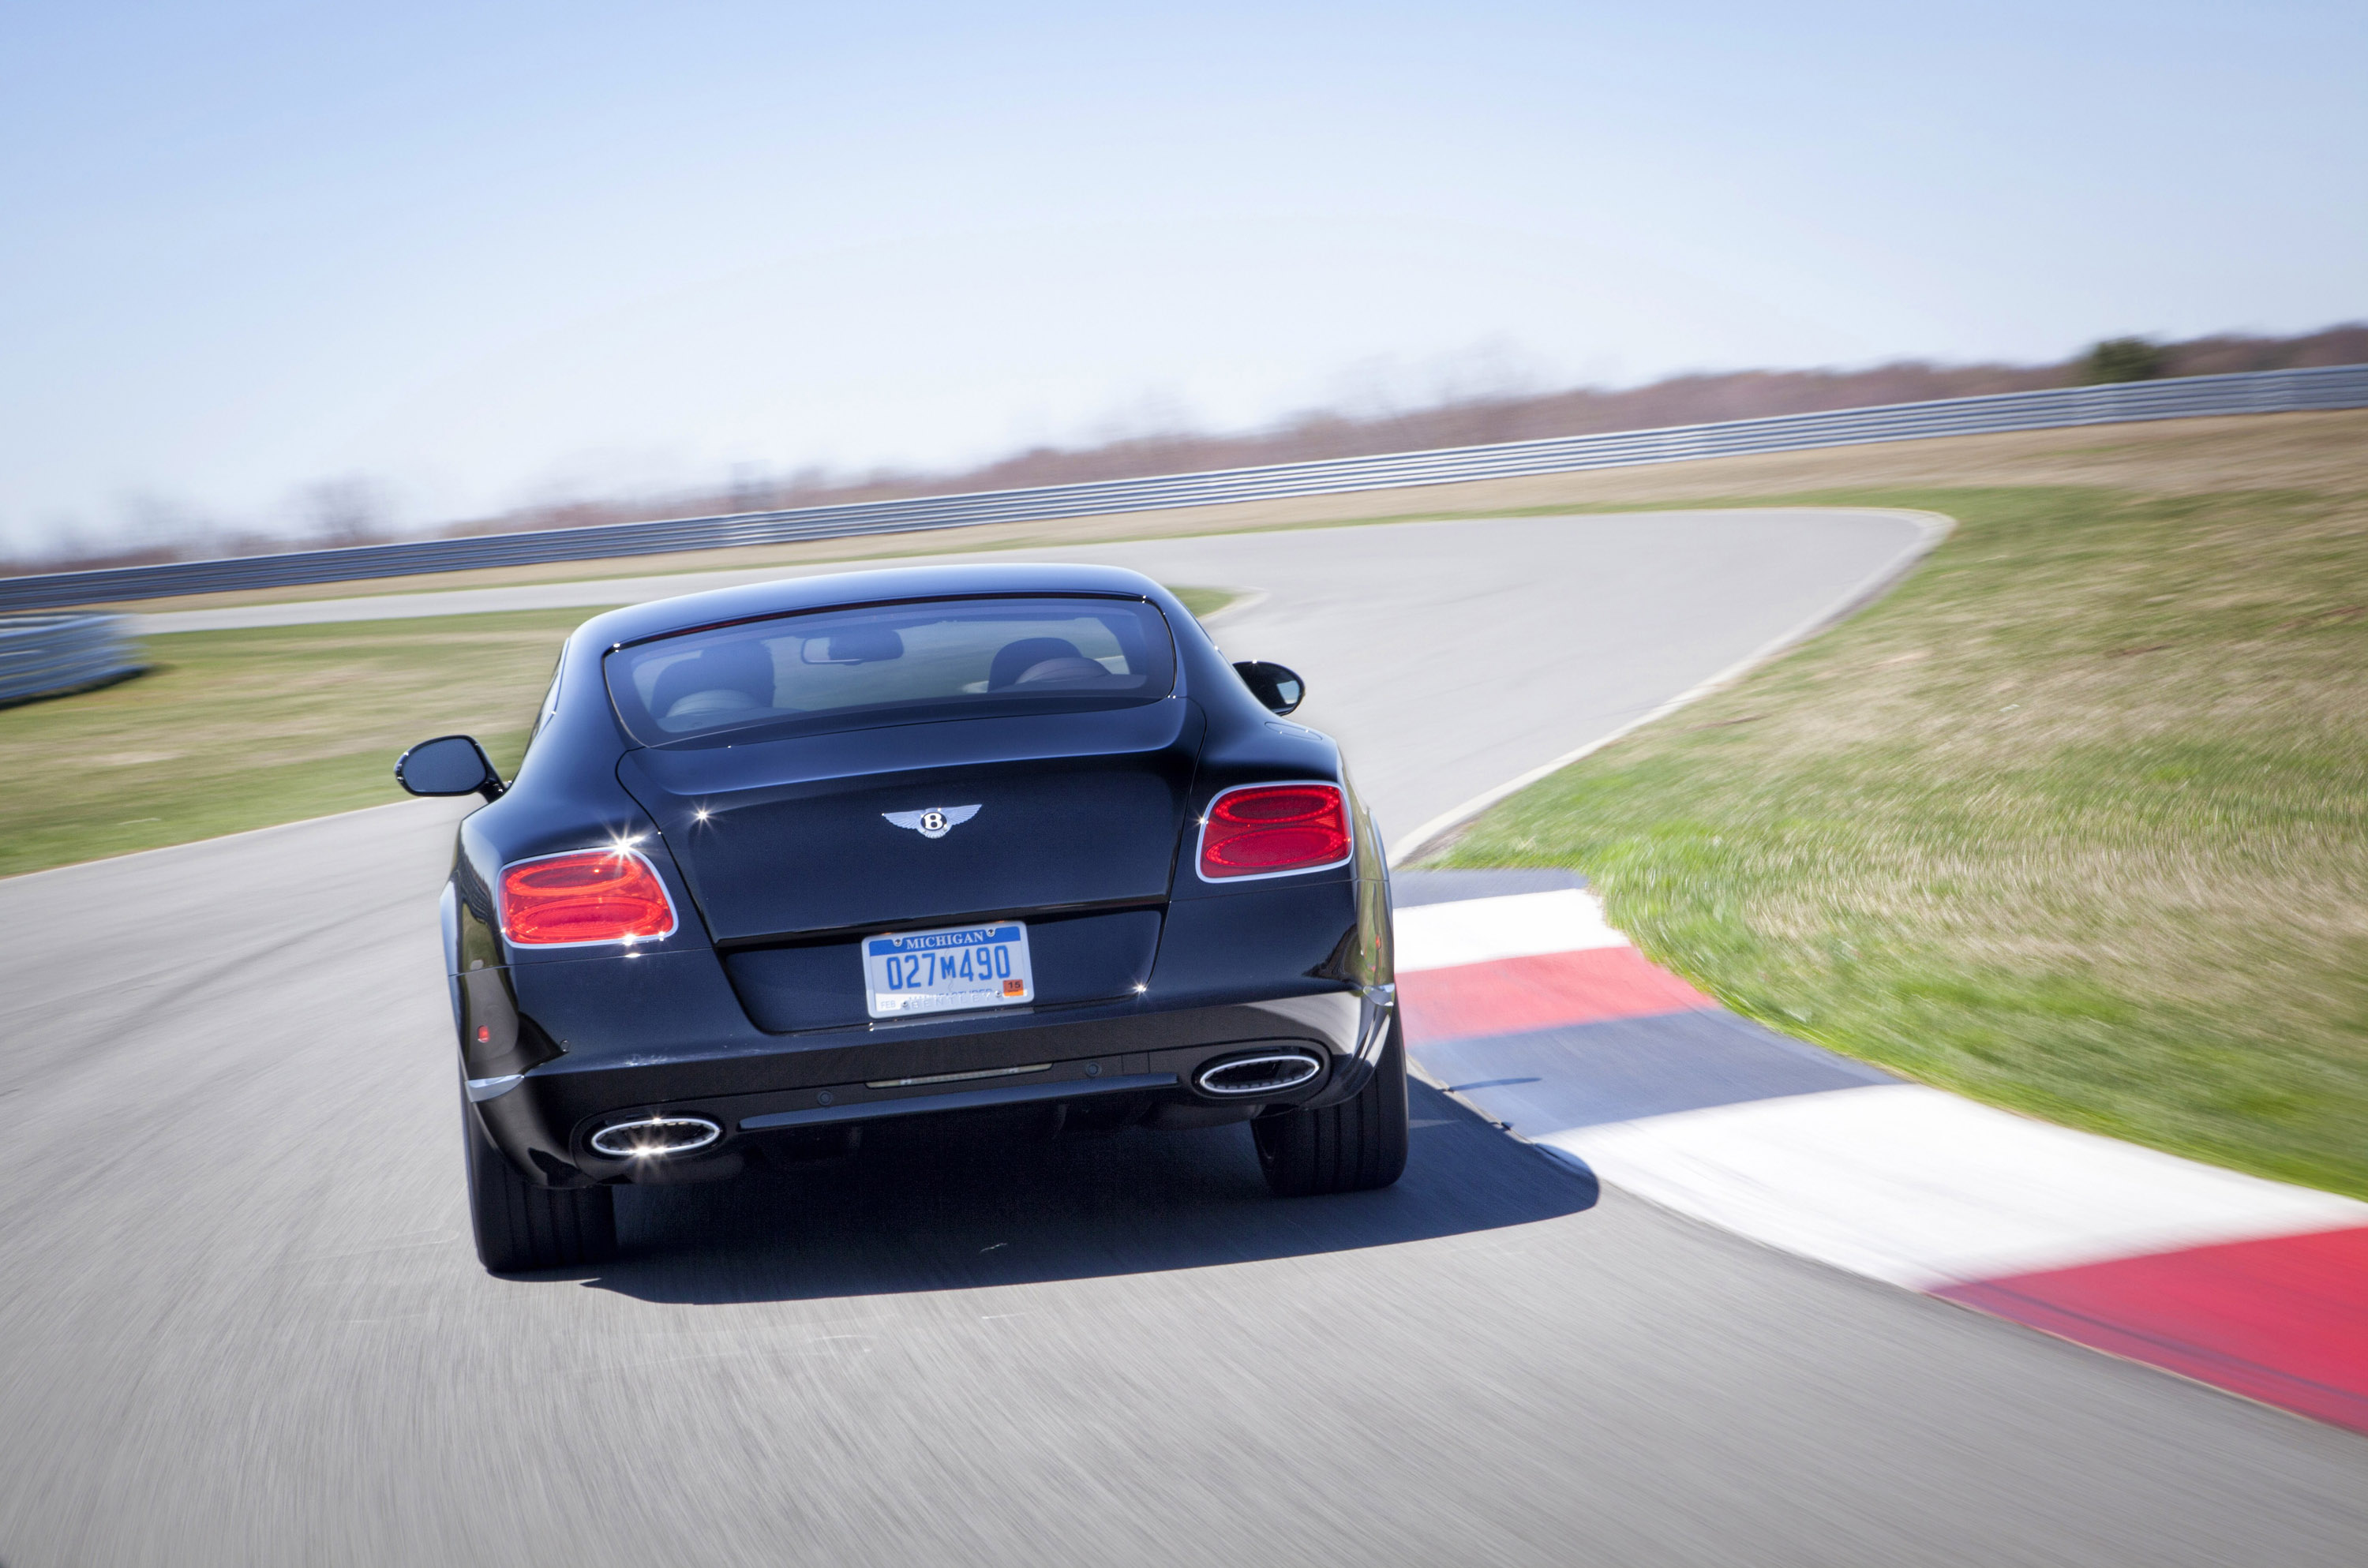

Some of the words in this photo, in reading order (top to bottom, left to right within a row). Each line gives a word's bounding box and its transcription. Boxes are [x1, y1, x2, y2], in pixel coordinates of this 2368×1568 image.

[924, 813, 942, 829] B
[906, 931, 984, 950] MICHIGAN
[886, 945, 1010, 990] 027M490
[880, 1000, 896, 1009] FEB
